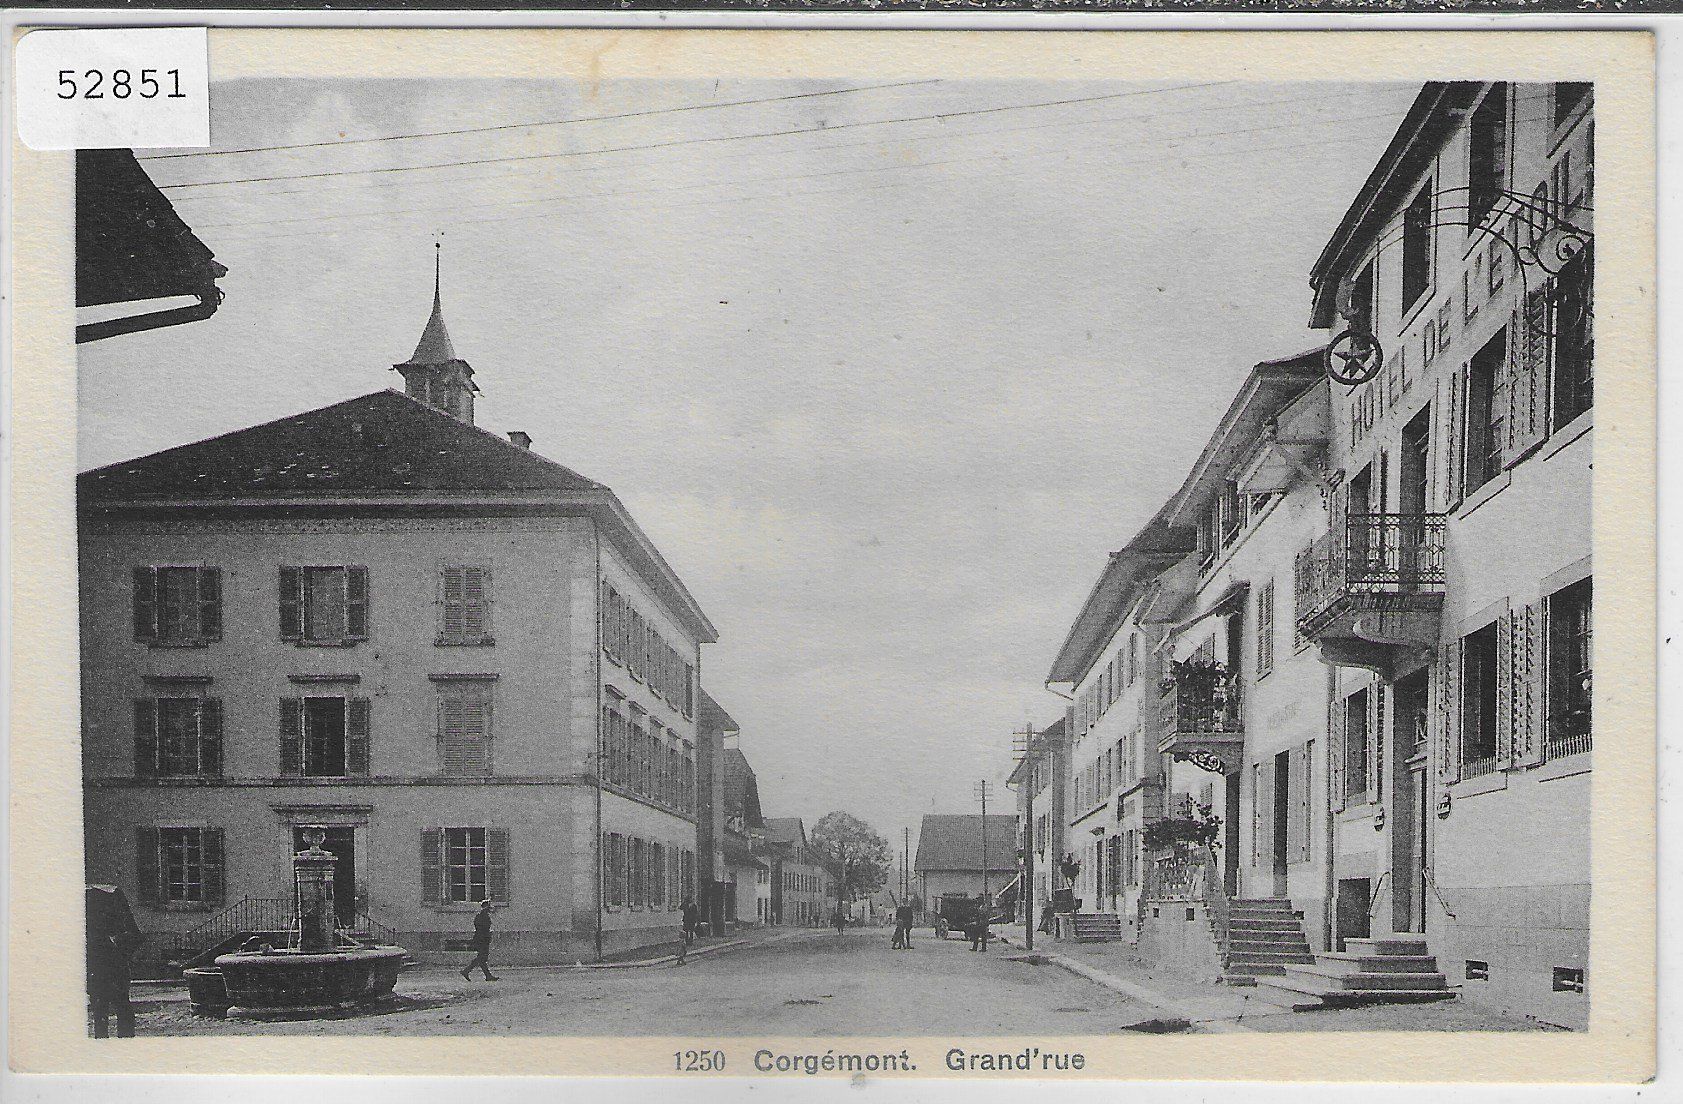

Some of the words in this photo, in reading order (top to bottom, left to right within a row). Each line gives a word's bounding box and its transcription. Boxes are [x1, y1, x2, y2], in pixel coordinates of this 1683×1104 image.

[57, 68, 186, 99] 52851
[1352, 343, 1413, 447] HOTEL
[1423, 297, 1451, 370] DE
